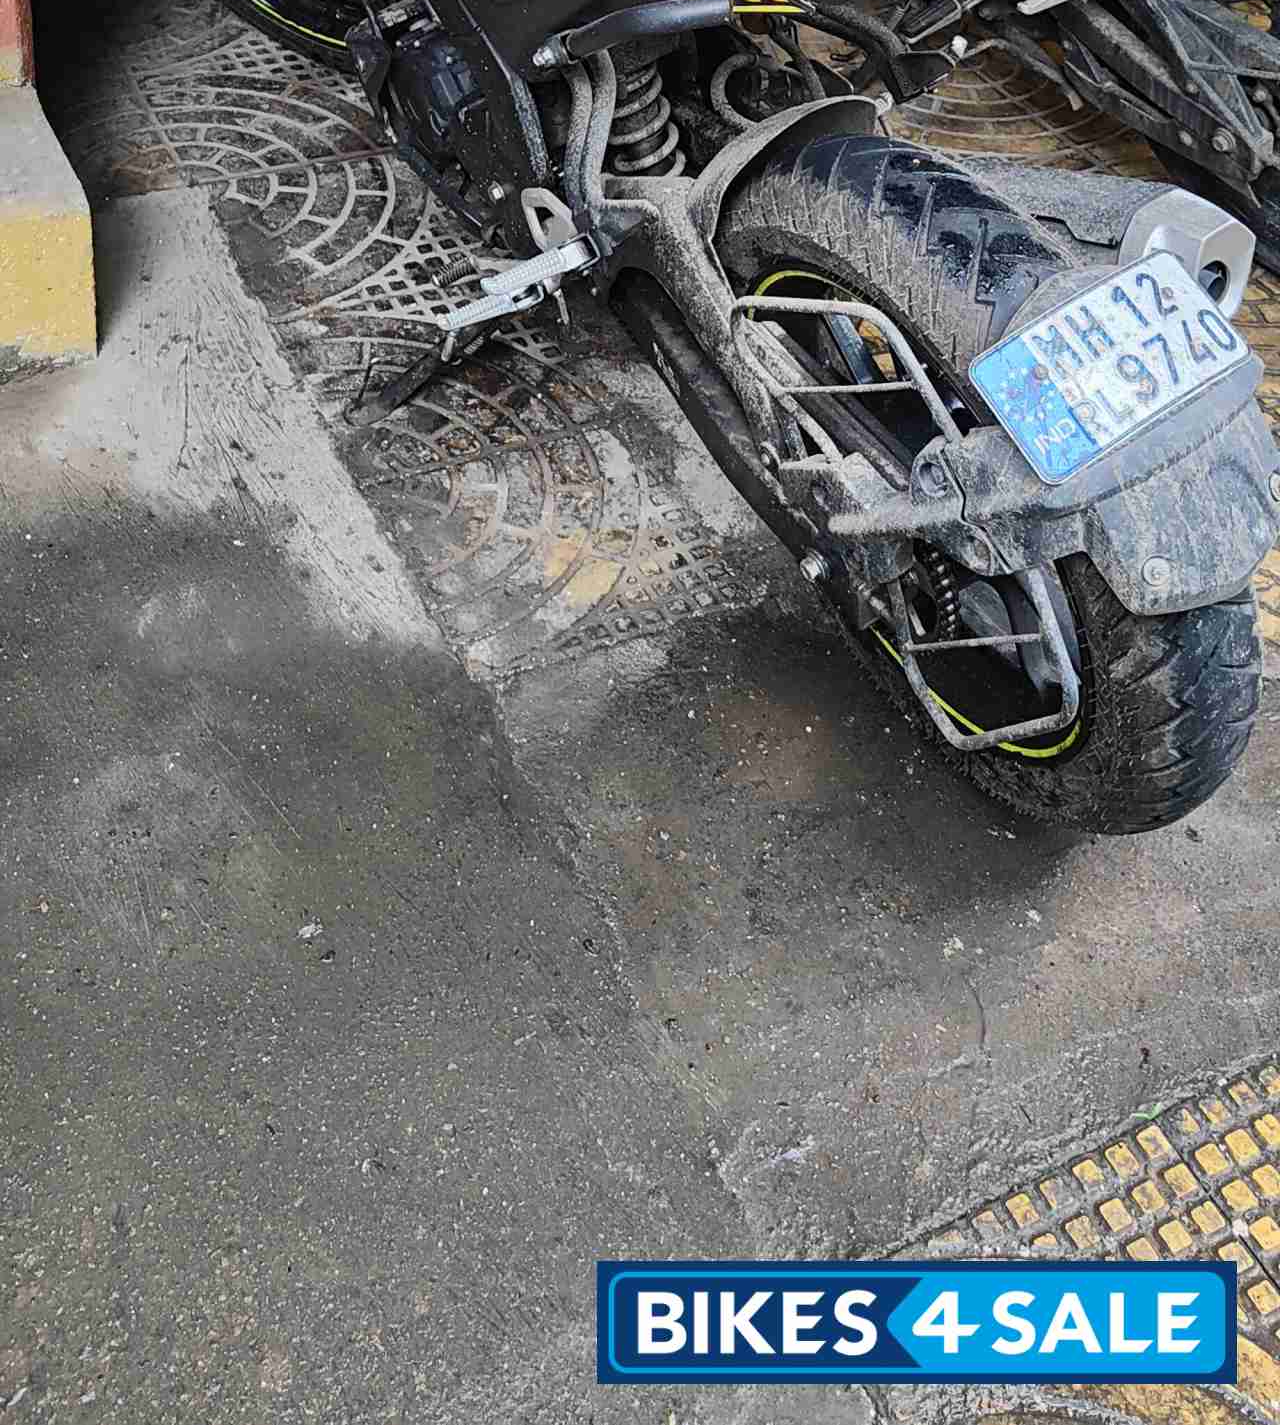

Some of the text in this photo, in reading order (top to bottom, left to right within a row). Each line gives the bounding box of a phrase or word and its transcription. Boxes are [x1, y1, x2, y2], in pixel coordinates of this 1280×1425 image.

[1032, 272, 1179, 373] MH 12
[1033, 418, 1076, 455] IND
